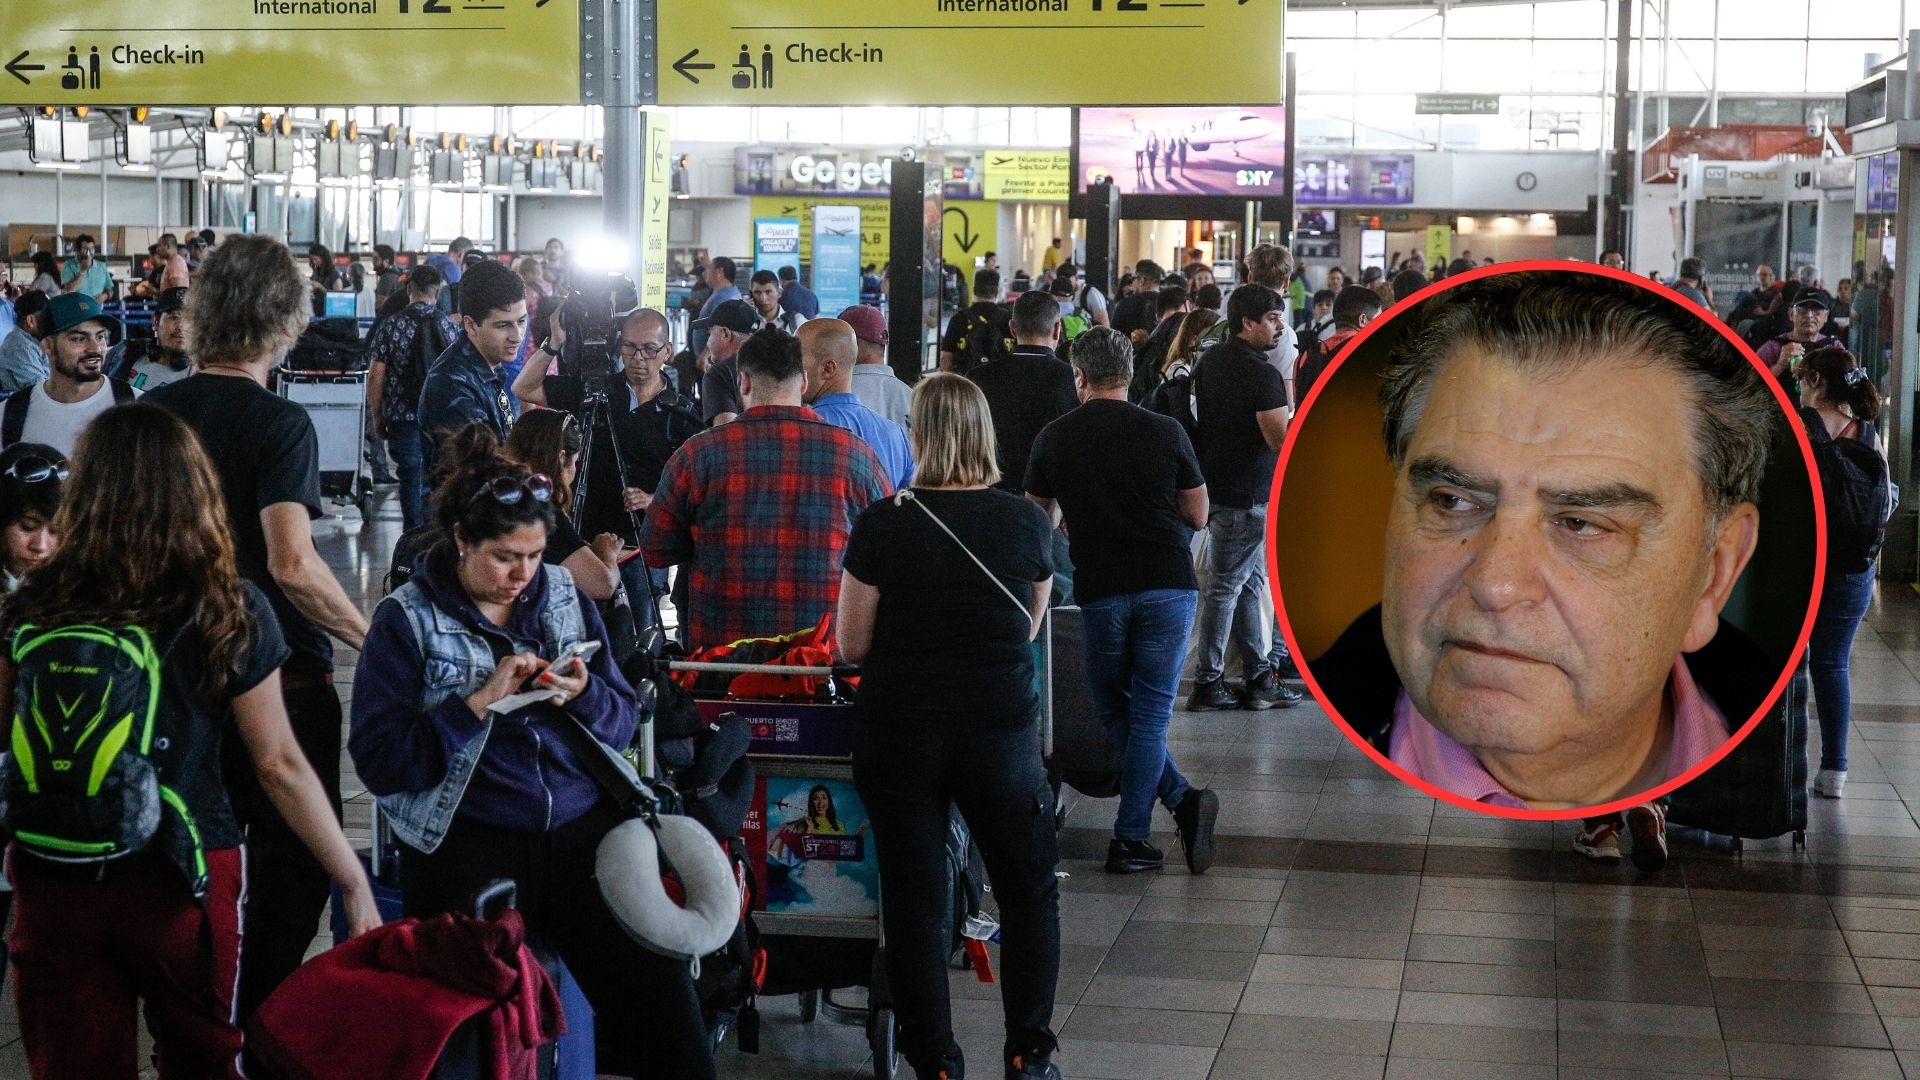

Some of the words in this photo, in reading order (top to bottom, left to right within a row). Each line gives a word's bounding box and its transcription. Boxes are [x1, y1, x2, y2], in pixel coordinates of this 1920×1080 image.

[254, 0, 377, 14] International
[937, 0, 1068, 11] International
[111, 44, 204, 64] Check-in
[785, 43, 883, 62] Check-in
[791, 155, 836, 184] Go
[1235, 170, 1274, 186] SKY
